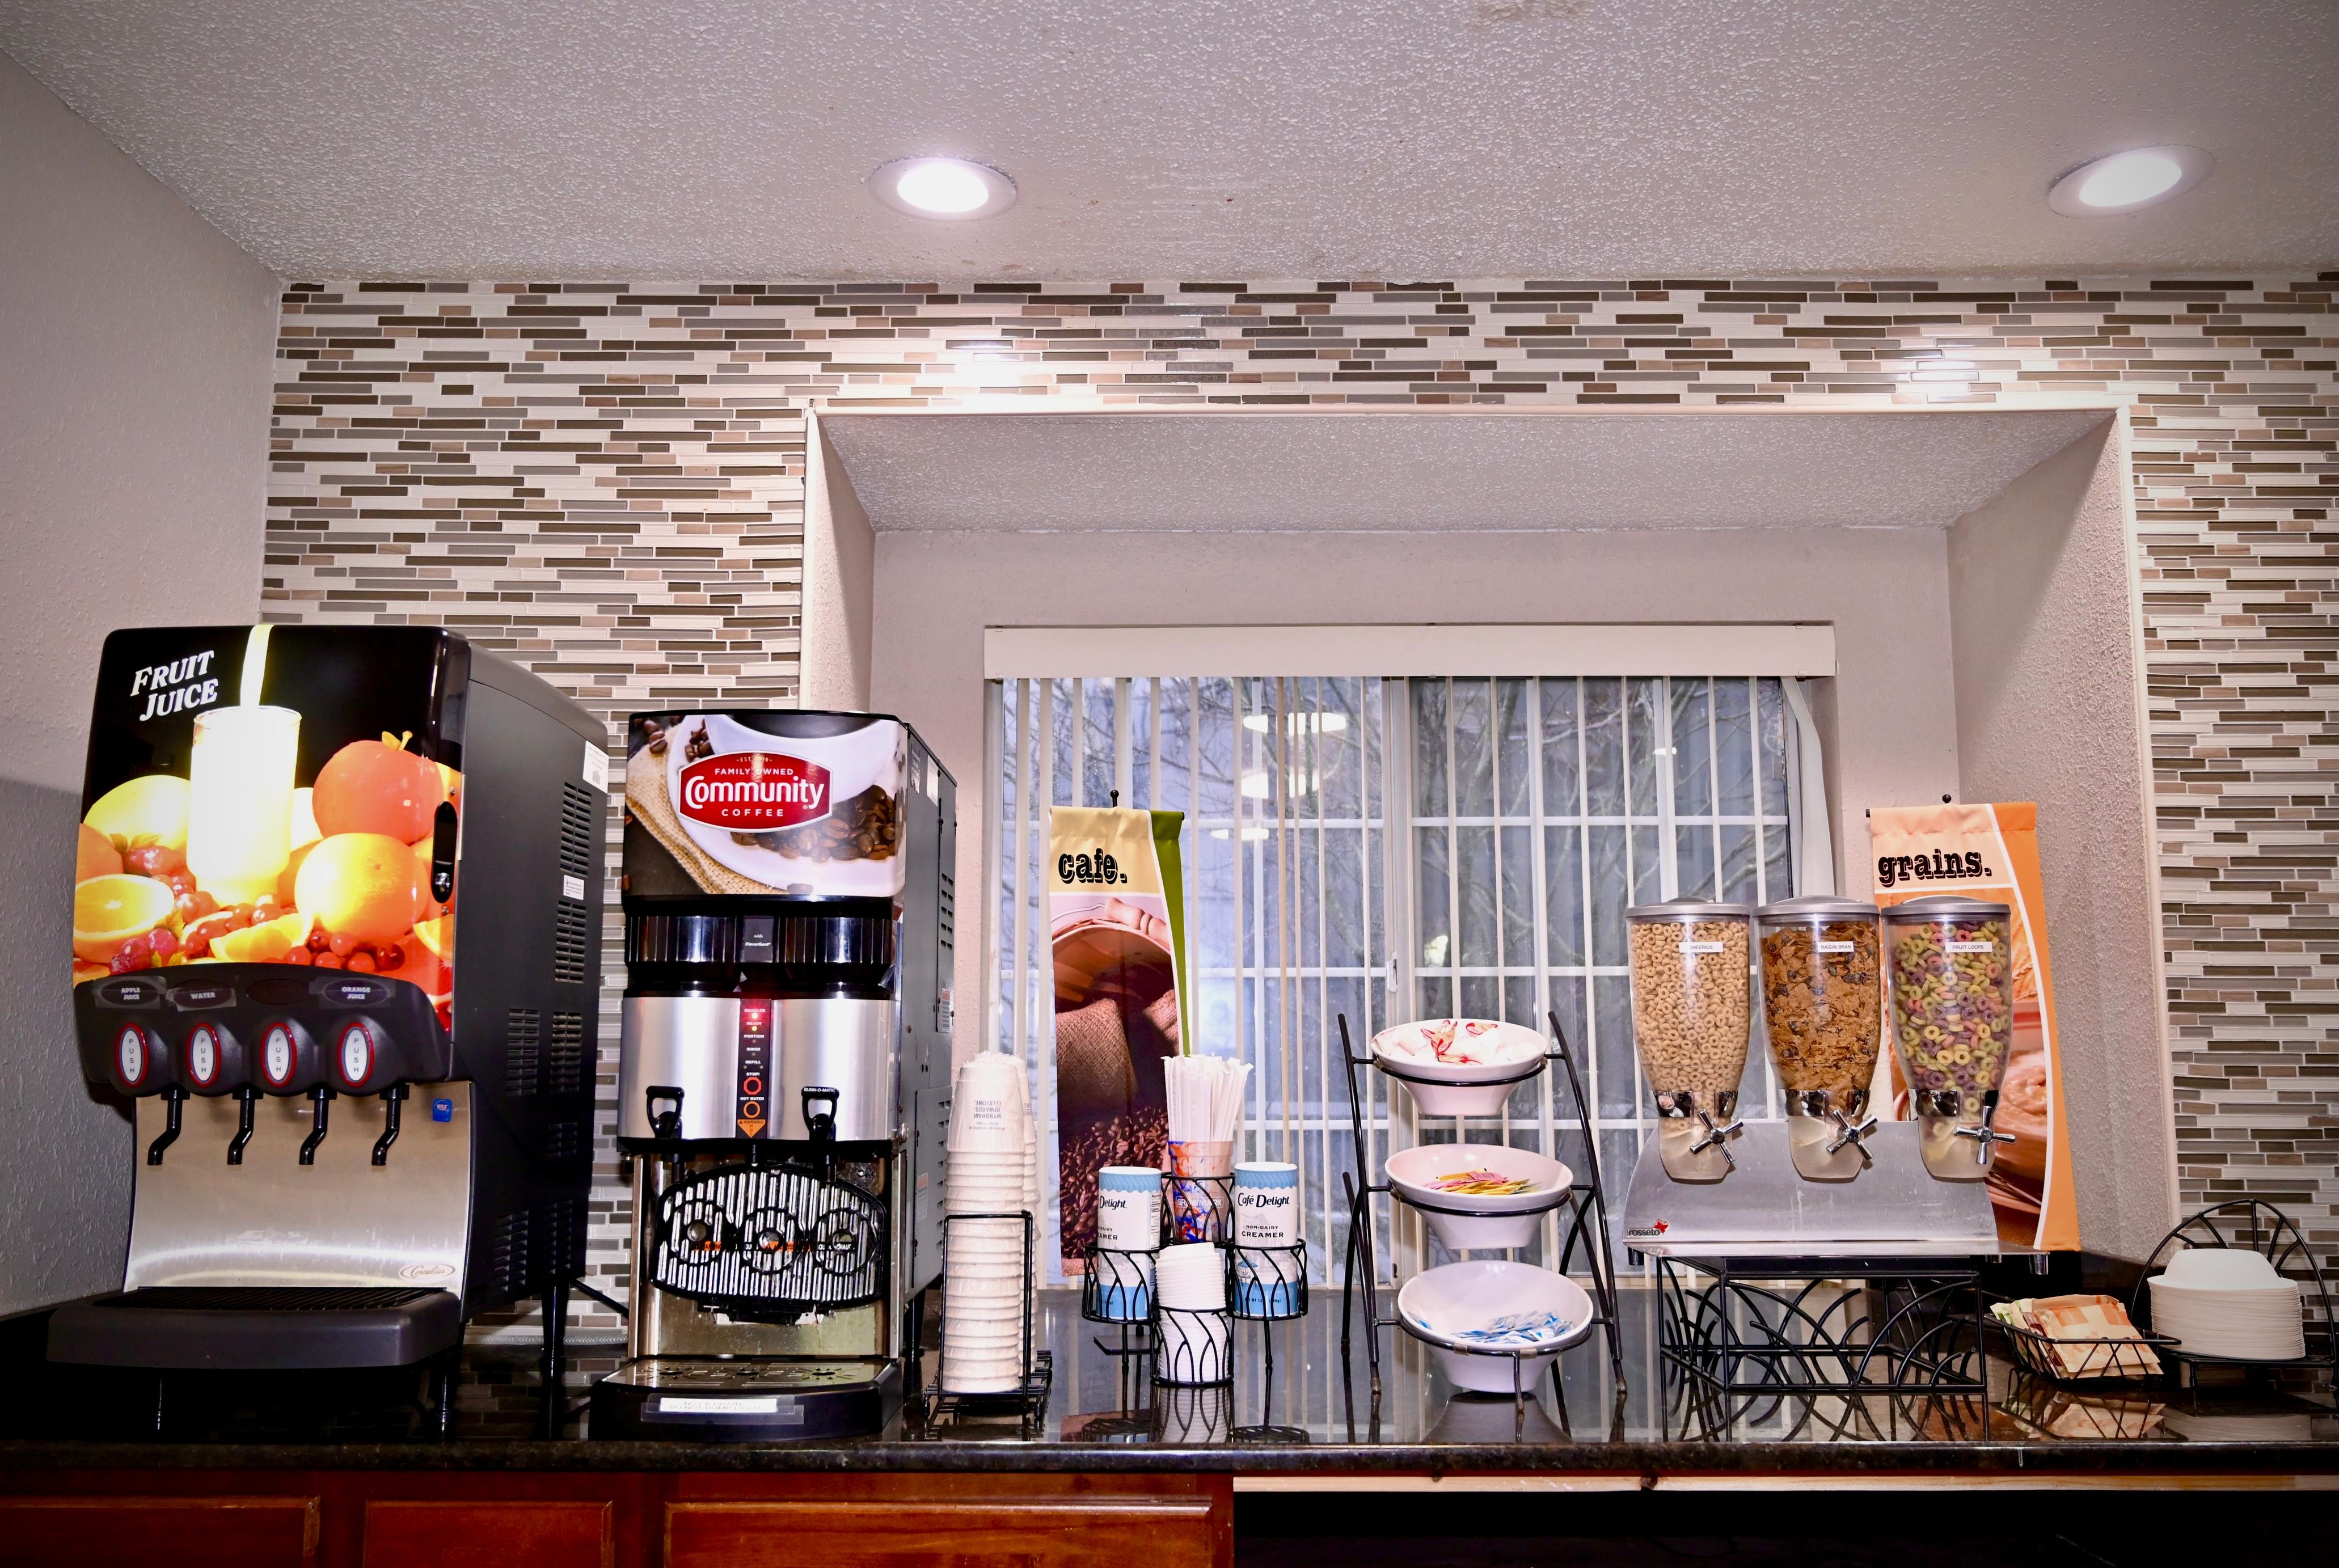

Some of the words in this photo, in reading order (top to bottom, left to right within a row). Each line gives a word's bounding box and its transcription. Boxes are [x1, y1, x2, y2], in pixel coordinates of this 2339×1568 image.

[130, 650, 214, 697] FRUIT
[140, 679, 219, 722] JUICE
[685, 775, 825, 810] Community
[1058, 848, 1128, 885] cafe.
[1878, 849, 1992, 888] grains.
[1099, 1195, 1126, 1210] Delight
[1238, 1193, 1254, 1206] Café
[1256, 1194, 1289, 1207] Delight
[411, 1265, 445, 1278] Cornelius
